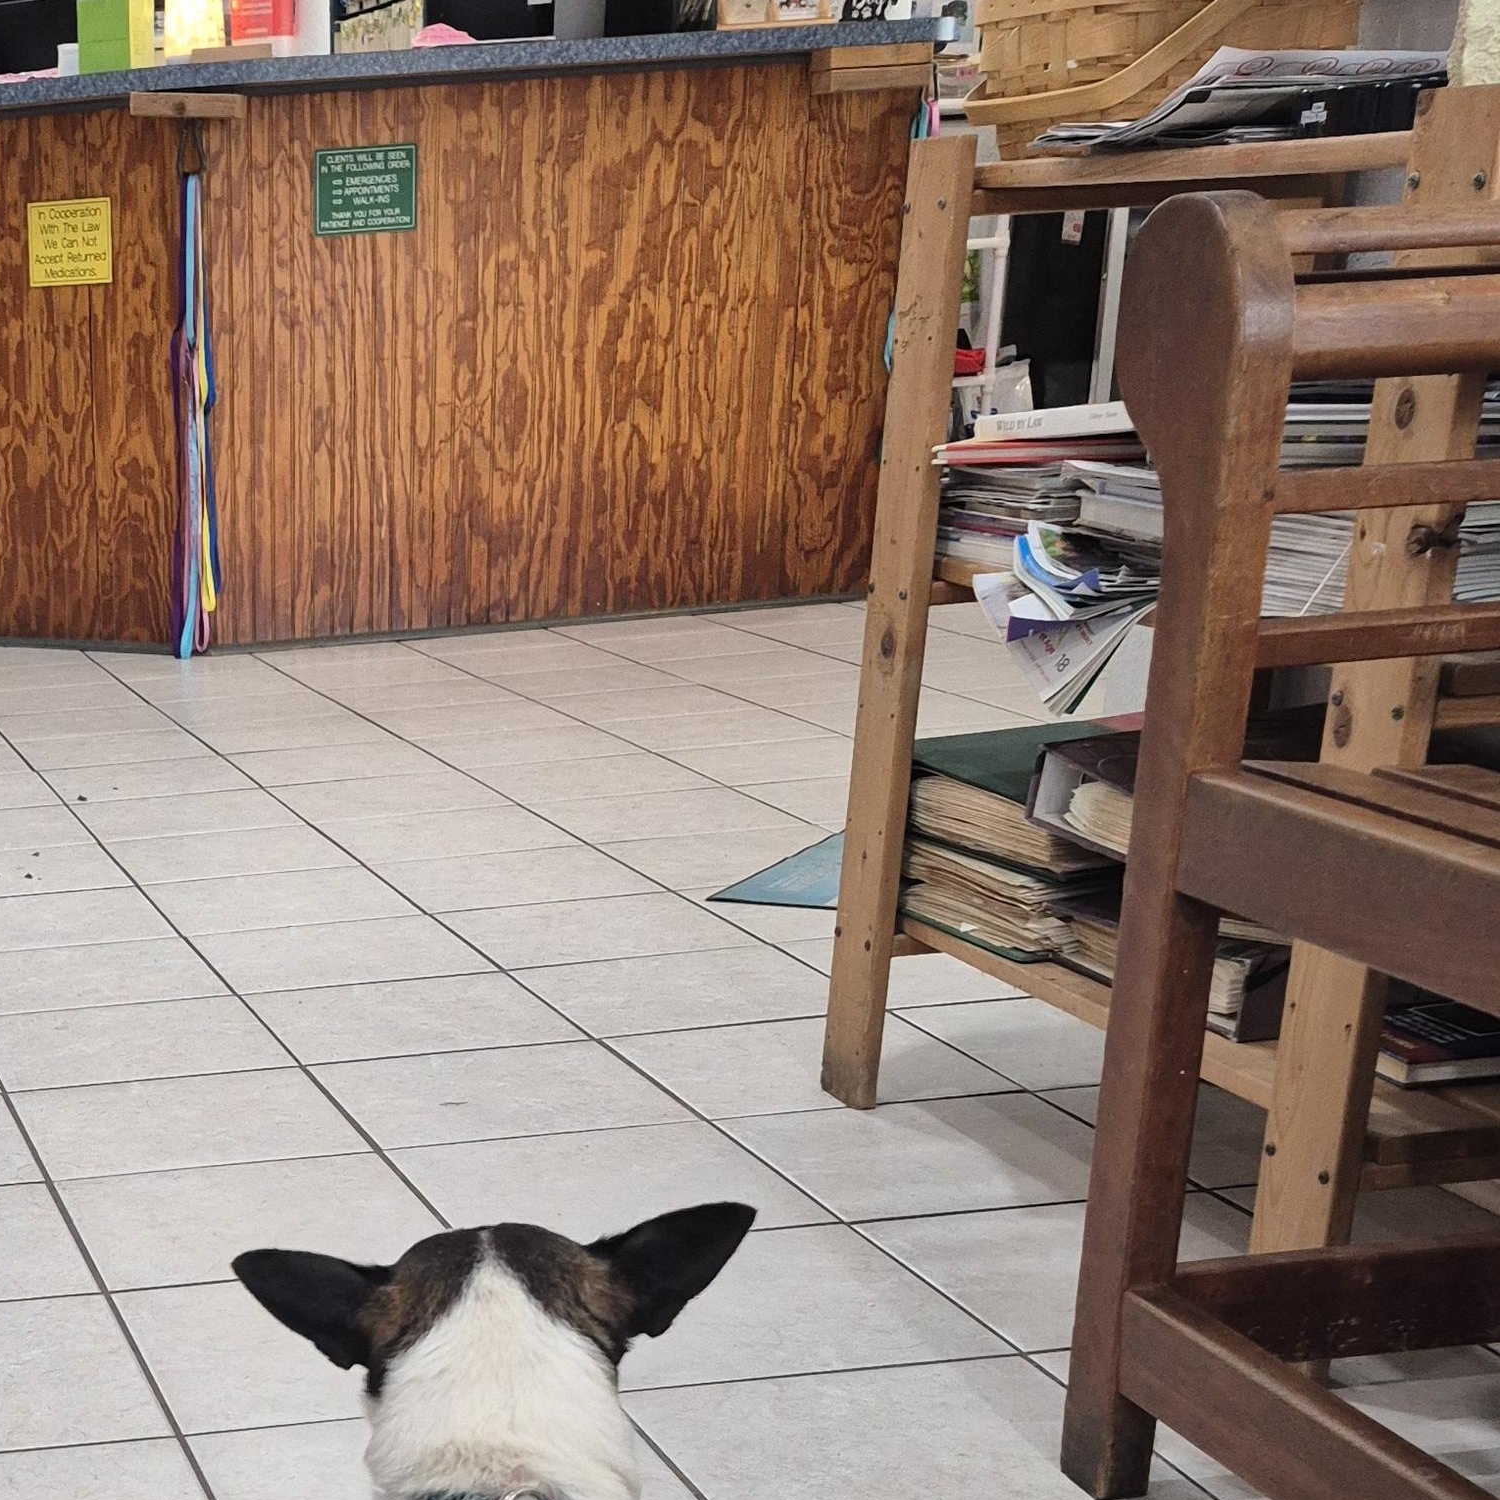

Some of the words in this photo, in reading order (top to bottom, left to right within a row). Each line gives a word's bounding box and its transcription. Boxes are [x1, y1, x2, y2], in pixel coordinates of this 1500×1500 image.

[326, 154, 354, 164] CLIENTS
[356, 153, 373, 162] WILL
[376, 152, 385, 161] BE
[387, 151, 406, 160] SEEN
[320, 165, 328, 174] IN
[330, 164, 343, 173] THE
[345, 162, 385, 172] FOLLOWING
[345, 174, 398, 186] EMERGENCIES
[343, 184, 400, 196] APPOINTMENTS
[352, 194, 391, 206] WALK-INS
[37, 210, 46, 220] In
[48, 207, 102, 220] Cooperation
[331, 211, 352, 220] THANK
[353, 210, 367, 218] YOU
[368, 208, 382, 217] FOR
[383, 207, 401, 216] YOUR
[39, 224, 59, 235] With
[63, 222, 78, 233] The
[82, 221, 101, 232] Law
[320, 220, 350, 229] PATIENCE
[352, 218, 366, 227] AND
[43, 239, 58, 250] We
[61, 237, 79, 249] Can
[82, 236, 97, 247] Not
[34, 253, 64, 265] Accept
[67, 250, 107, 262] Returned
[1054, 653, 1071, 673] 18
